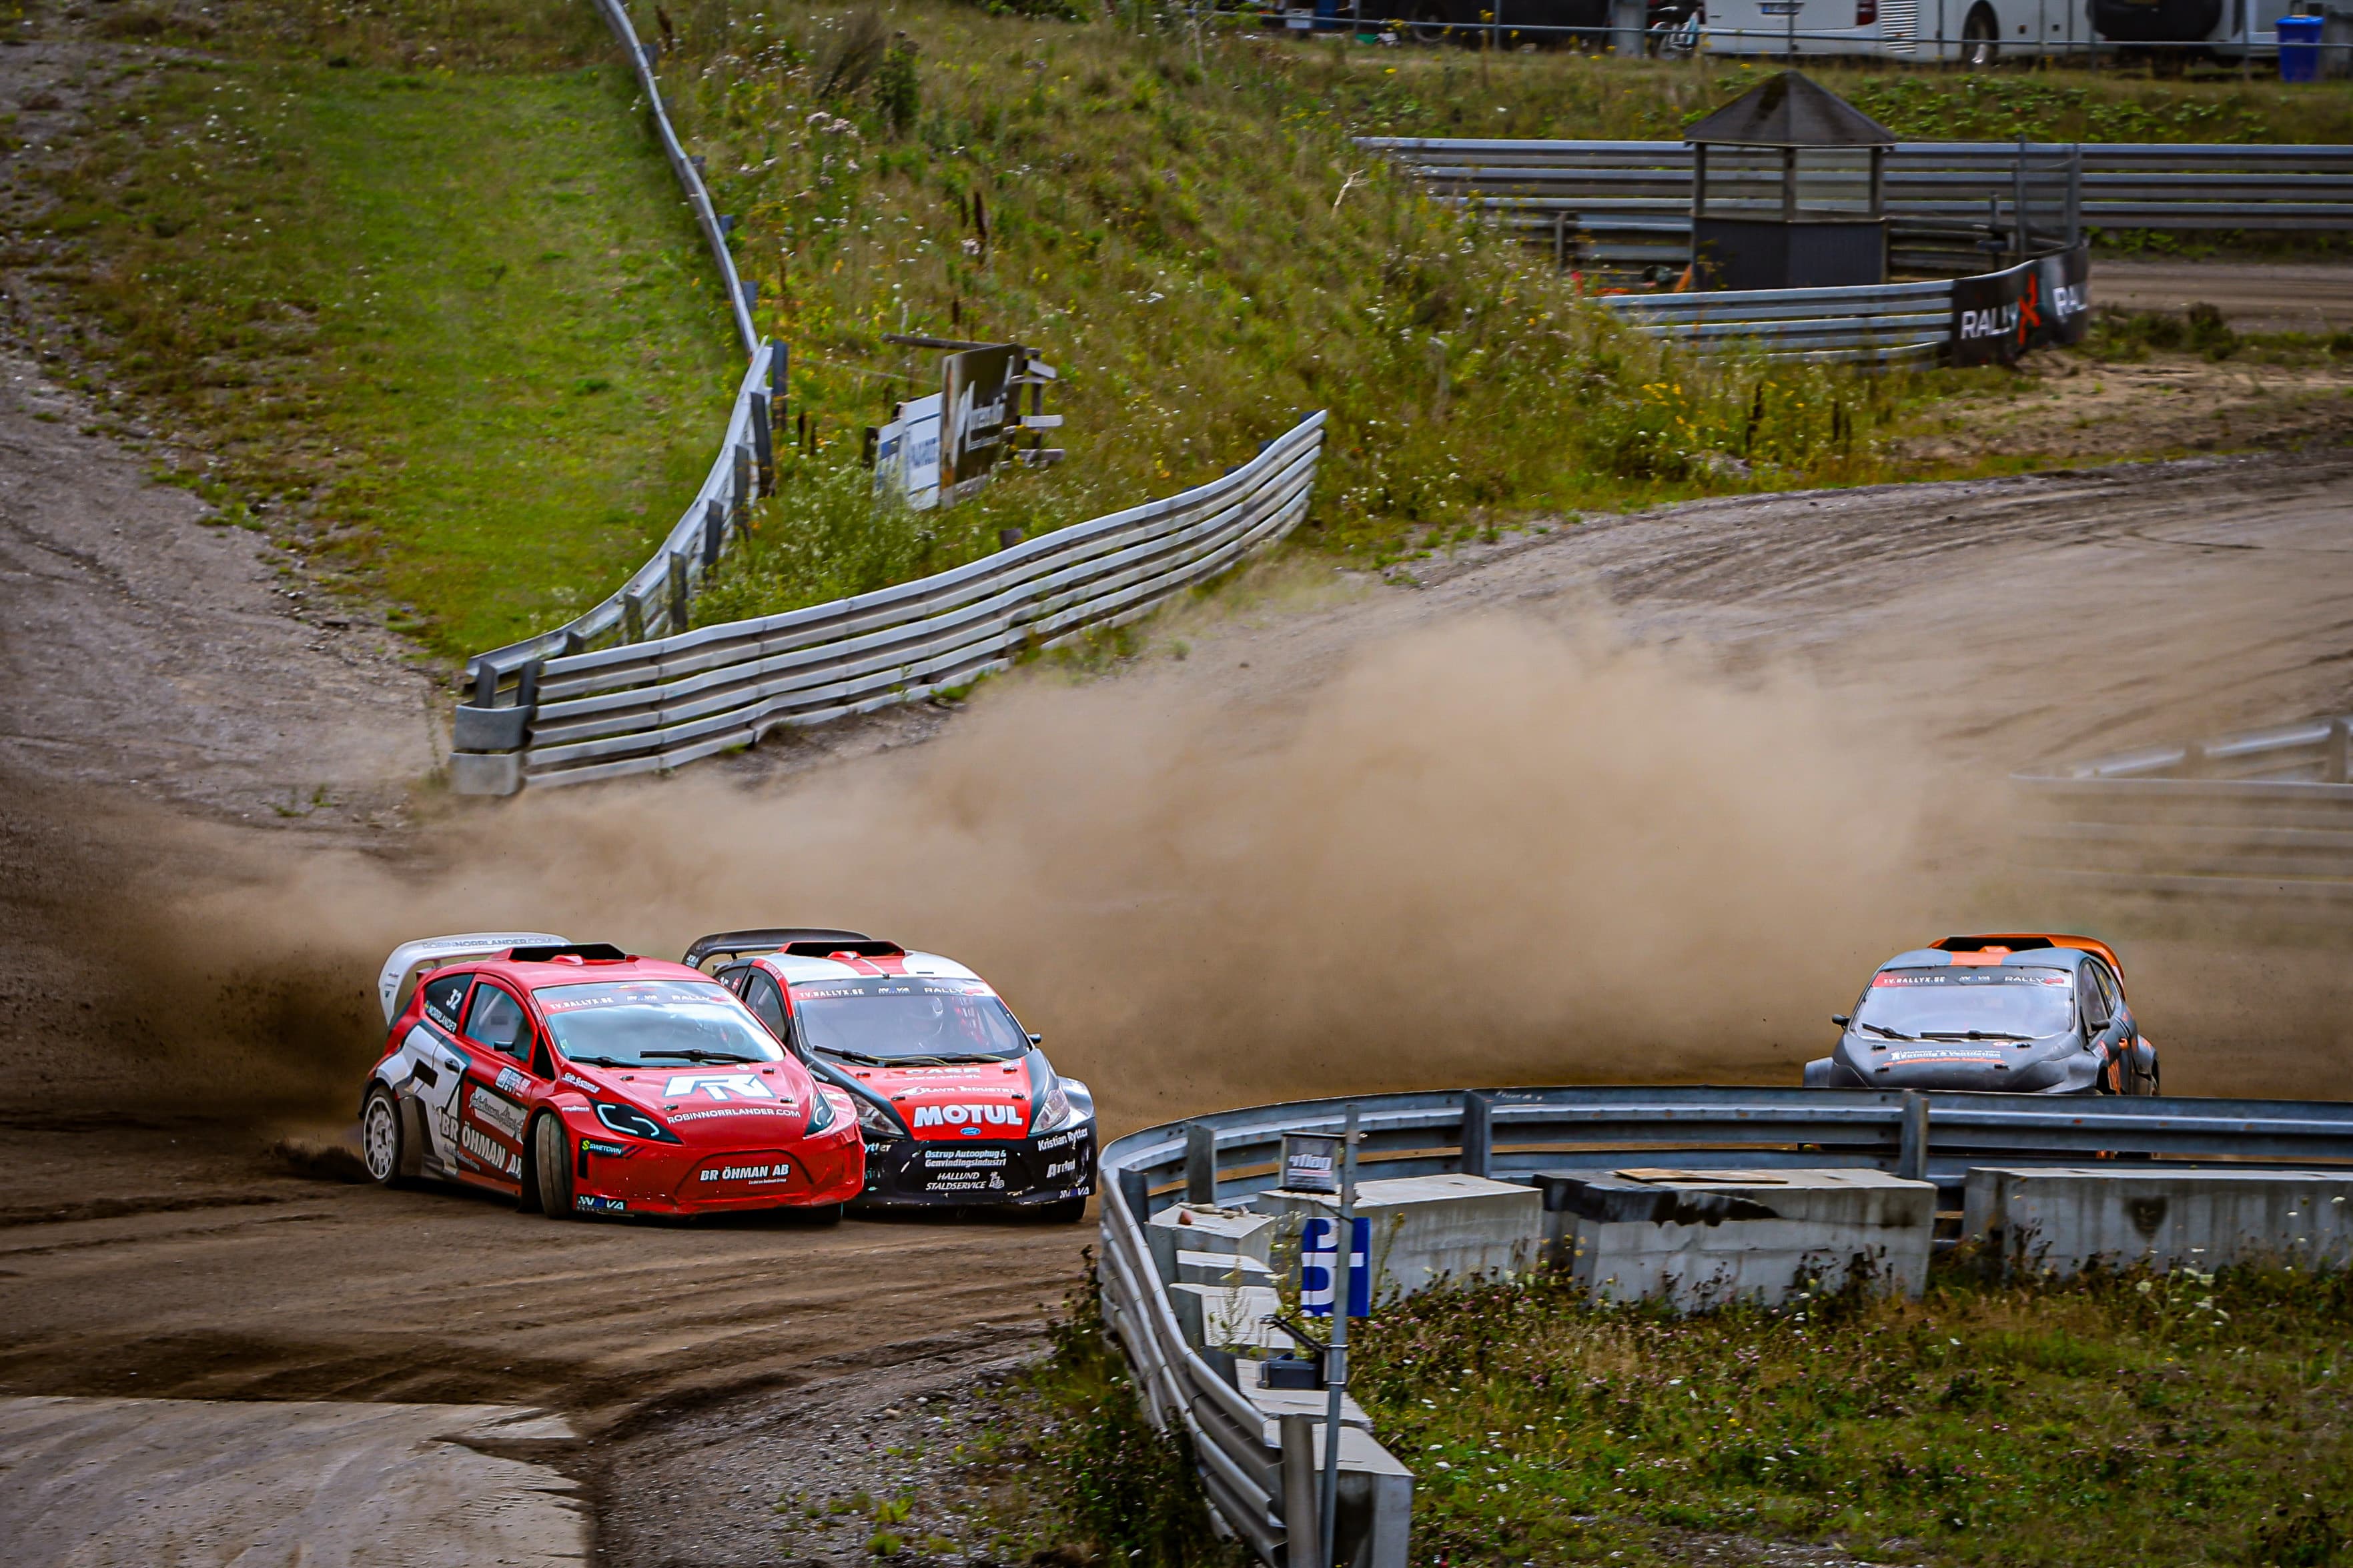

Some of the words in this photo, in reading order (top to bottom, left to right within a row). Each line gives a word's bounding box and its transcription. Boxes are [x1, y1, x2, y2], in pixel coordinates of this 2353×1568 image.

[422, 938, 552, 950] ROBINNORRLANDER.COM
[446, 988, 462, 1011] 32
[428, 1003, 458, 1033] NORRLANDER
[666, 1107, 801, 1124] ROBINNORRLANDER.COM
[913, 1104, 1023, 1128] MOTUL
[462, 1120, 506, 1169] ÖHMAN
[1037, 1134, 1067, 1152] Kristian
[1067, 1127, 1088, 1142] Rytter
[589, 1143, 622, 1155] SWETOWN
[955, 1149, 1000, 1158] Autoophug
[1000, 1149, 1007, 1158] &
[925, 1158, 1007, 1168] Genvindingsindustri
[700, 1169, 719, 1181] BR
[722, 1166, 769, 1180] ÖHMAN
[772, 1164, 789, 1177] AB
[937, 1171, 980, 1181] HALLUND
[925, 1181, 987, 1191] STALDSERVICE
